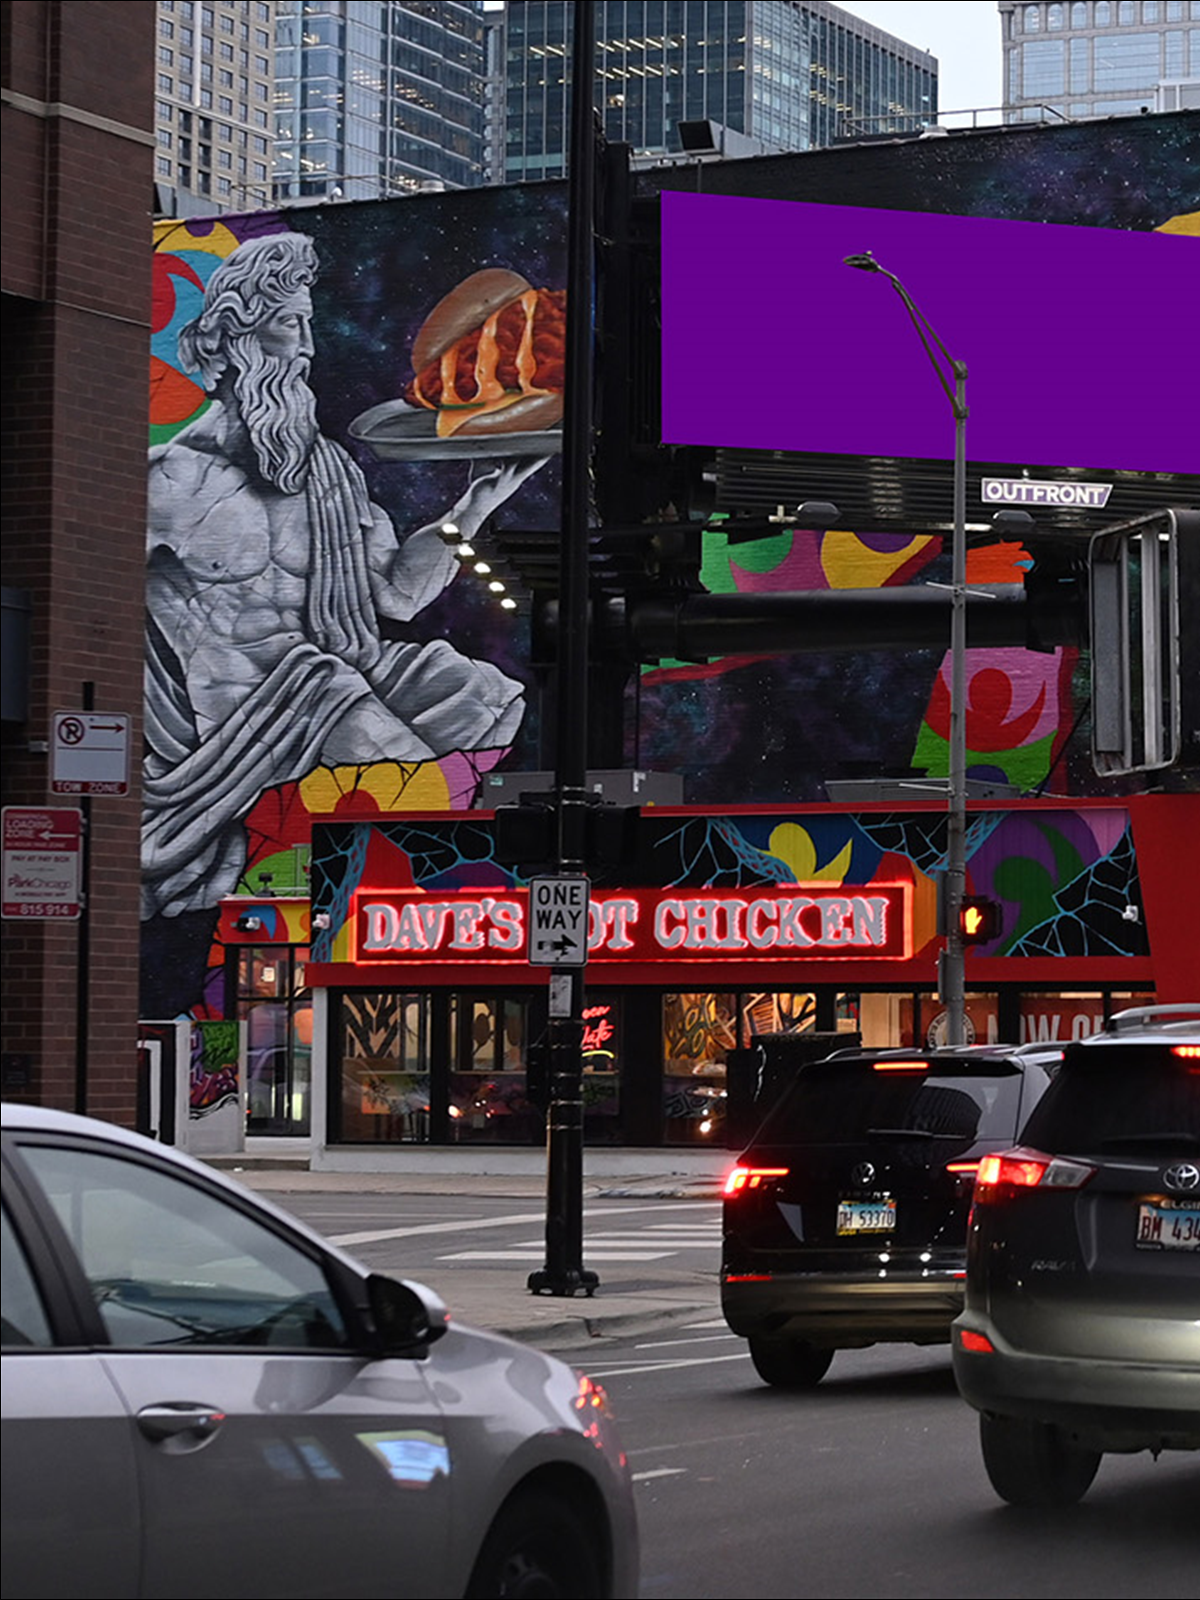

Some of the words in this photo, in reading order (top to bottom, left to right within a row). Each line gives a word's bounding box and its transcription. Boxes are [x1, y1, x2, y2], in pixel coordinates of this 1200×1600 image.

[986, 481, 1105, 505] OUTFRONT
[56, 782, 82, 792] TOW
[88, 782, 121, 793] ZONE
[5, 820, 54, 829] LOADING
[5, 830, 36, 838] ZONE
[537, 885, 582, 906] ONE
[20, 903, 44, 915] 815
[45, 904, 70, 915] 914
[536, 909, 583, 930] WAY
[362, 898, 524, 951] DAVE'S
[587, 898, 640, 950] OT
[654, 896, 889, 949] CHICKEN
[1141, 1216, 1163, 1240] BM
